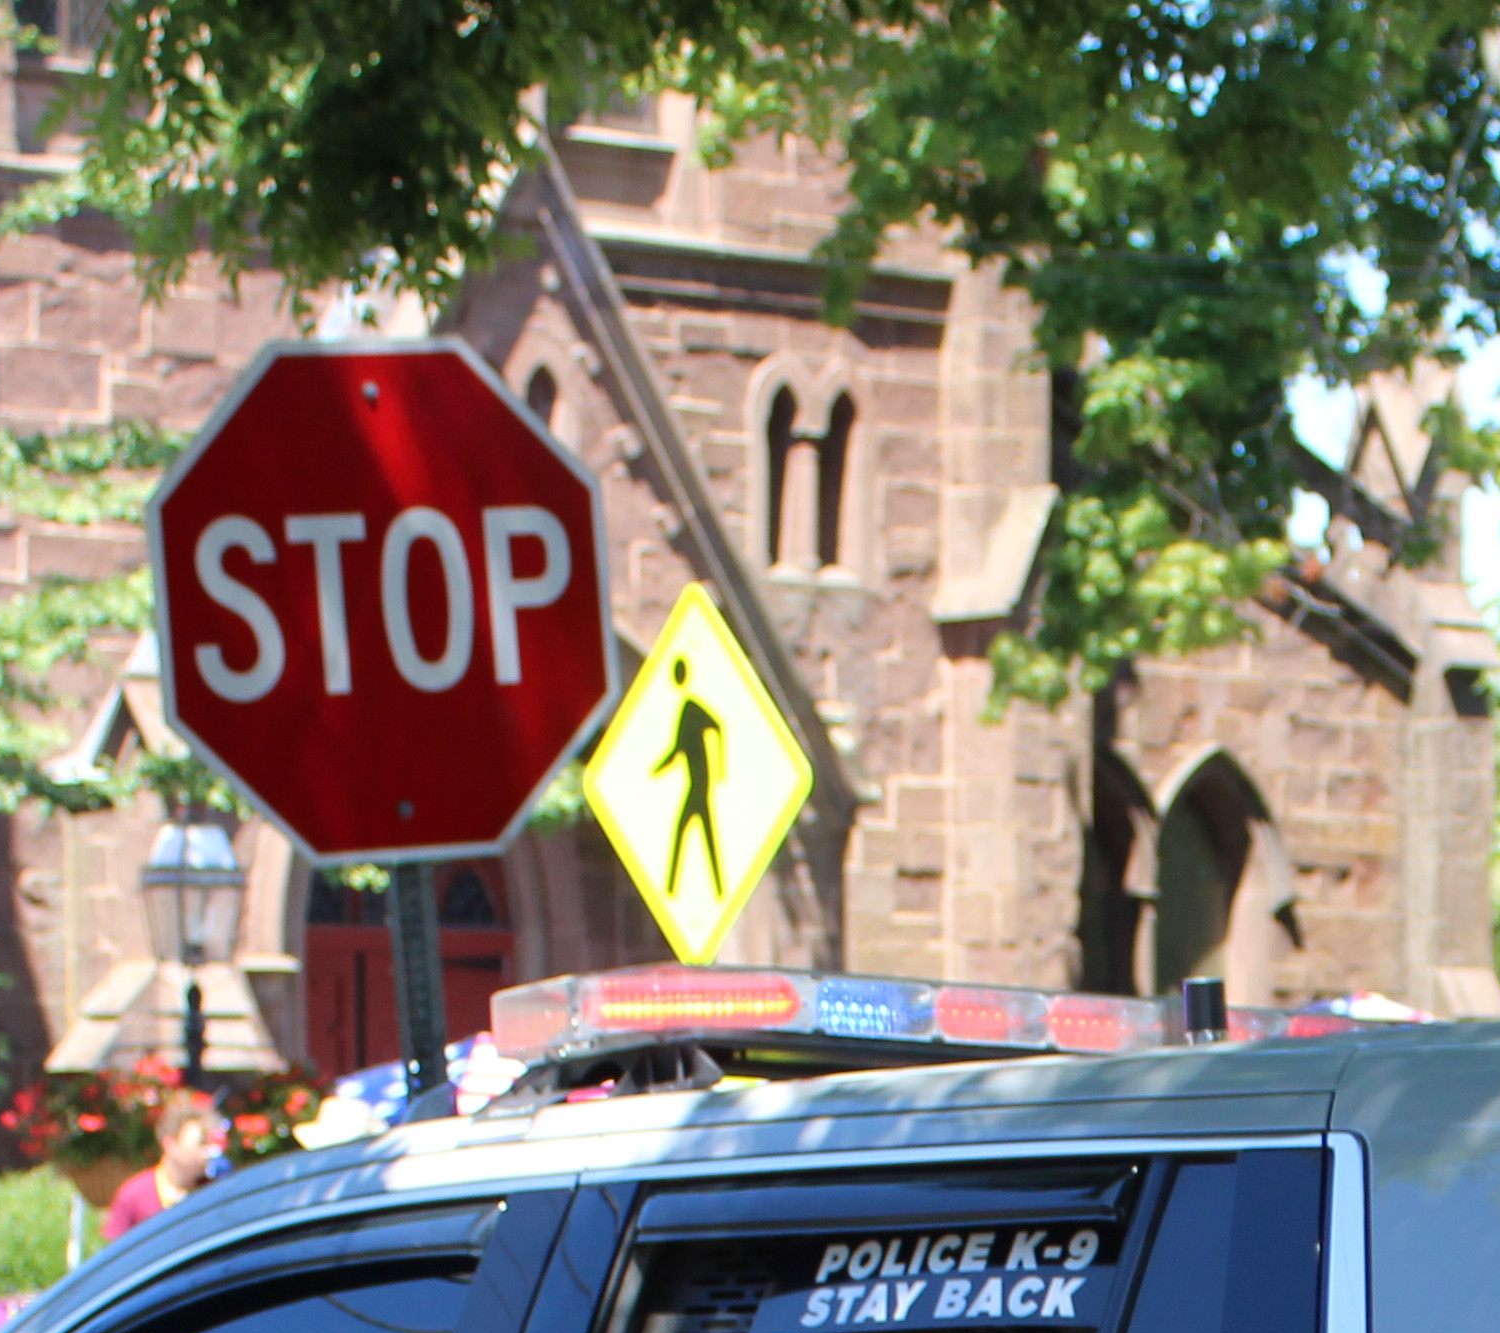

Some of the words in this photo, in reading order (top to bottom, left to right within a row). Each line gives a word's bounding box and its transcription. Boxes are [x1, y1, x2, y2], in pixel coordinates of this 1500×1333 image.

[194, 505, 572, 703] STOP
[814, 1231, 996, 1284] POLICE
[1004, 1229, 1099, 1272] K-9
[799, 1279, 926, 1328] STAY
[933, 1276, 1088, 1319] BACK
